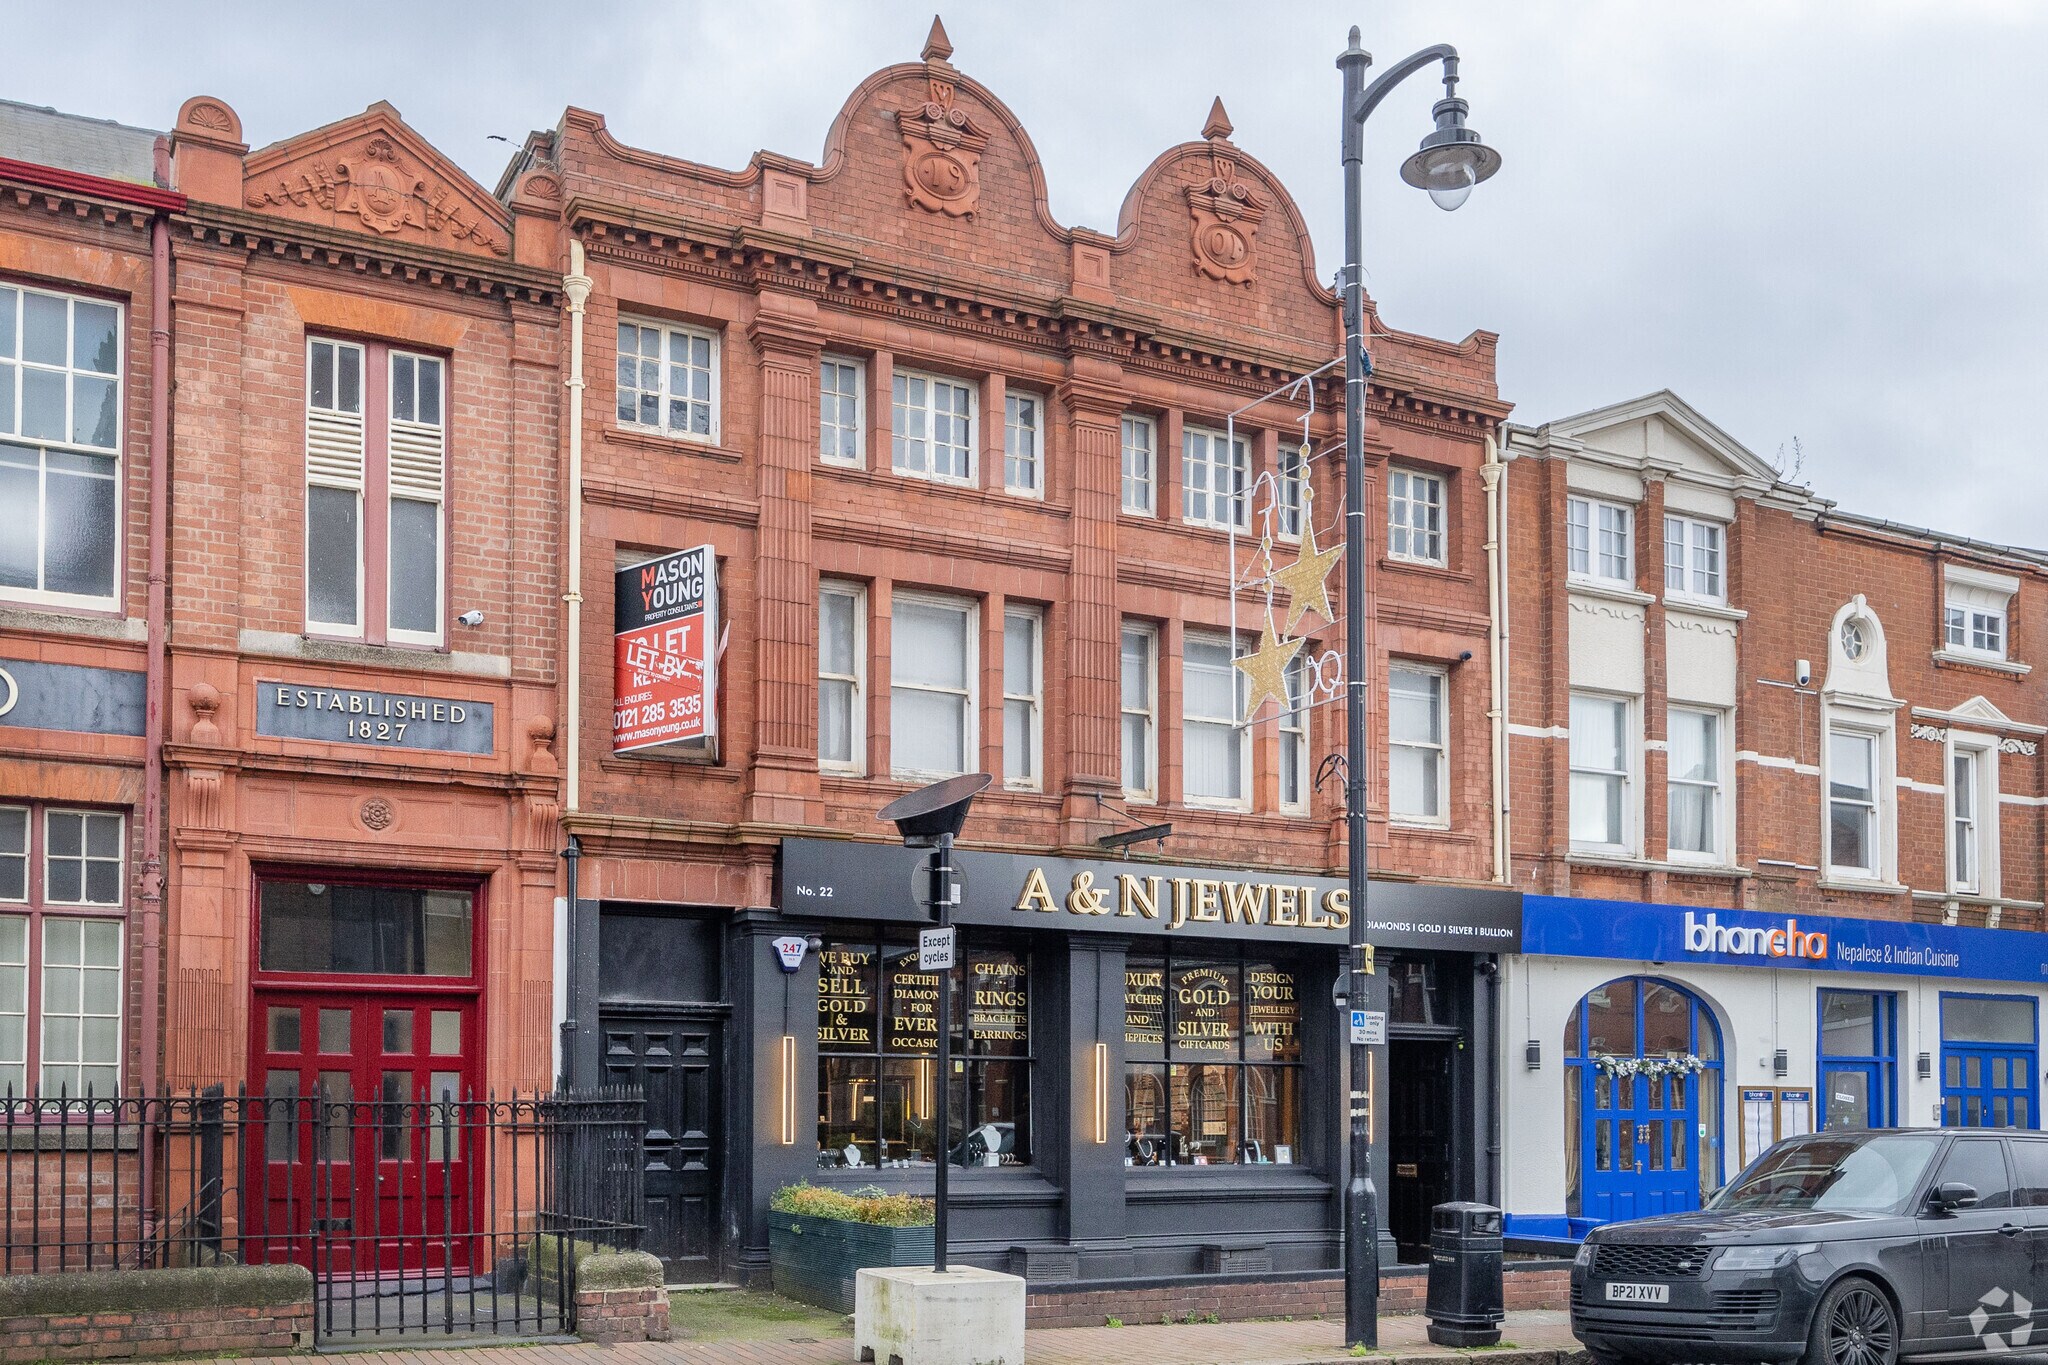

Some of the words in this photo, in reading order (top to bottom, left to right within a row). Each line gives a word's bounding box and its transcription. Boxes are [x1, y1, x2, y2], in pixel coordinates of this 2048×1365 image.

[641, 552, 703, 589] MASON
[641, 577, 703, 611] YOUNG
[645, 610, 668, 621] PROPERTY
[667, 601, 698, 616] CONSULTANTS
[626, 644, 659, 671] LET
[277, 688, 466, 723] ESTABLISHED
[613, 708, 638, 730] 0121
[642, 702, 665, 724] 285
[669, 694, 701, 718] 3535
[348, 719, 407, 741] 1827
[613, 717, 701, 743] www.masonyoung.co.uk
[797, 886, 816, 896] No.
[820, 886, 833, 897] 22
[1016, 867, 1059, 912] A
[1066, 870, 1110, 915] &
[1117, 873, 1163, 919] N
[1165, 877, 1350, 930] JEWELS
[1366, 920, 1410, 932] DIAMONDS
[1417, 923, 1441, 933] GOLD
[1448, 925, 1473, 935] SILVER
[1479, 928, 1513, 938] BULLION
[783, 943, 801, 953] 247
[923, 934, 950, 948] Except
[818, 952, 836, 963] WE
[841, 952, 869, 965] BUY
[900, 952, 919, 967] EXQ
[924, 951, 949, 965] cycles
[1837, 941, 1882, 965] Nepalese
[1884, 944, 1892, 963] &
[1894, 945, 1923, 965] Indian
[1924, 947, 1959, 967] Cuisine
[830, 966, 854, 975] AND
[975, 964, 1026, 976] CHAINS
[1181, 968, 1228, 986] PREMIUM
[894, 974, 939, 986] CERTIFI
[1125, 973, 1162, 987] UXURY
[1251, 972, 1294, 984] DESIGN
[818, 978, 865, 994] SELL
[1251, 985, 1294, 1000] YOUR
[894, 989, 939, 1000] DIAMON
[975, 990, 1026, 1006] RINGS
[1125, 993, 1162, 1005] ATCHES
[1178, 989, 1230, 1005] GOLD
[818, 999, 866, 1013] GOLD
[911, 1003, 932, 1013] FOR
[1195, 1008, 1215, 1017] AND
[1250, 1005, 1295, 1014] JEWELLERY
[836, 1013, 848, 1025] &
[894, 1016, 938, 1032] EVER
[974, 1014, 1027, 1023] BRACELETS
[1126, 1014, 1149, 1024] AND
[818, 1027, 869, 1041] SILVER
[974, 1030, 1027, 1040] EARRINGS
[1178, 1021, 1230, 1037] SILVER
[1251, 1022, 1293, 1036] WITH
[1178, 1040, 1230, 1050] GIFTCARDS
[1263, 1038, 1283, 1051] US
[1612, 1285, 1636, 1299] BP21
[1638, 1286, 1661, 1300] XVV
